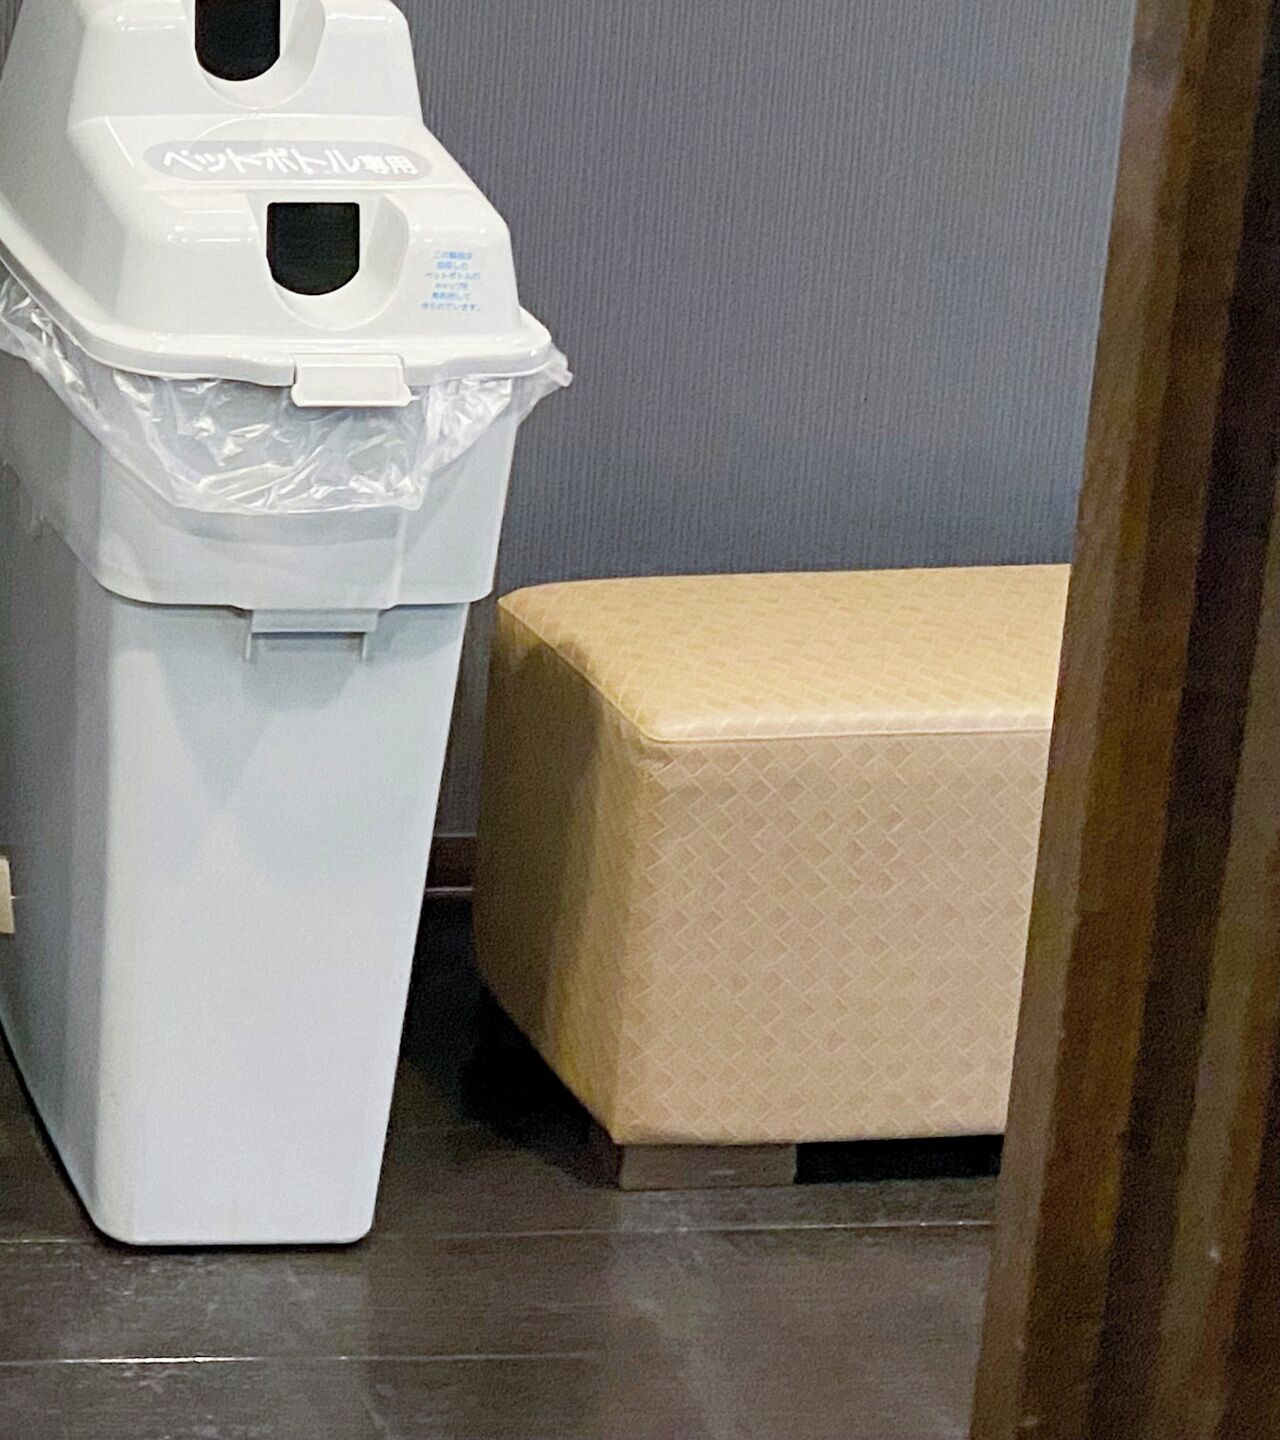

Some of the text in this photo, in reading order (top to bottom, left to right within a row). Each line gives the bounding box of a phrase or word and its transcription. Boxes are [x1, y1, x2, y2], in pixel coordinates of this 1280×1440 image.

[162, 147, 419, 176] ペットボトル専用
